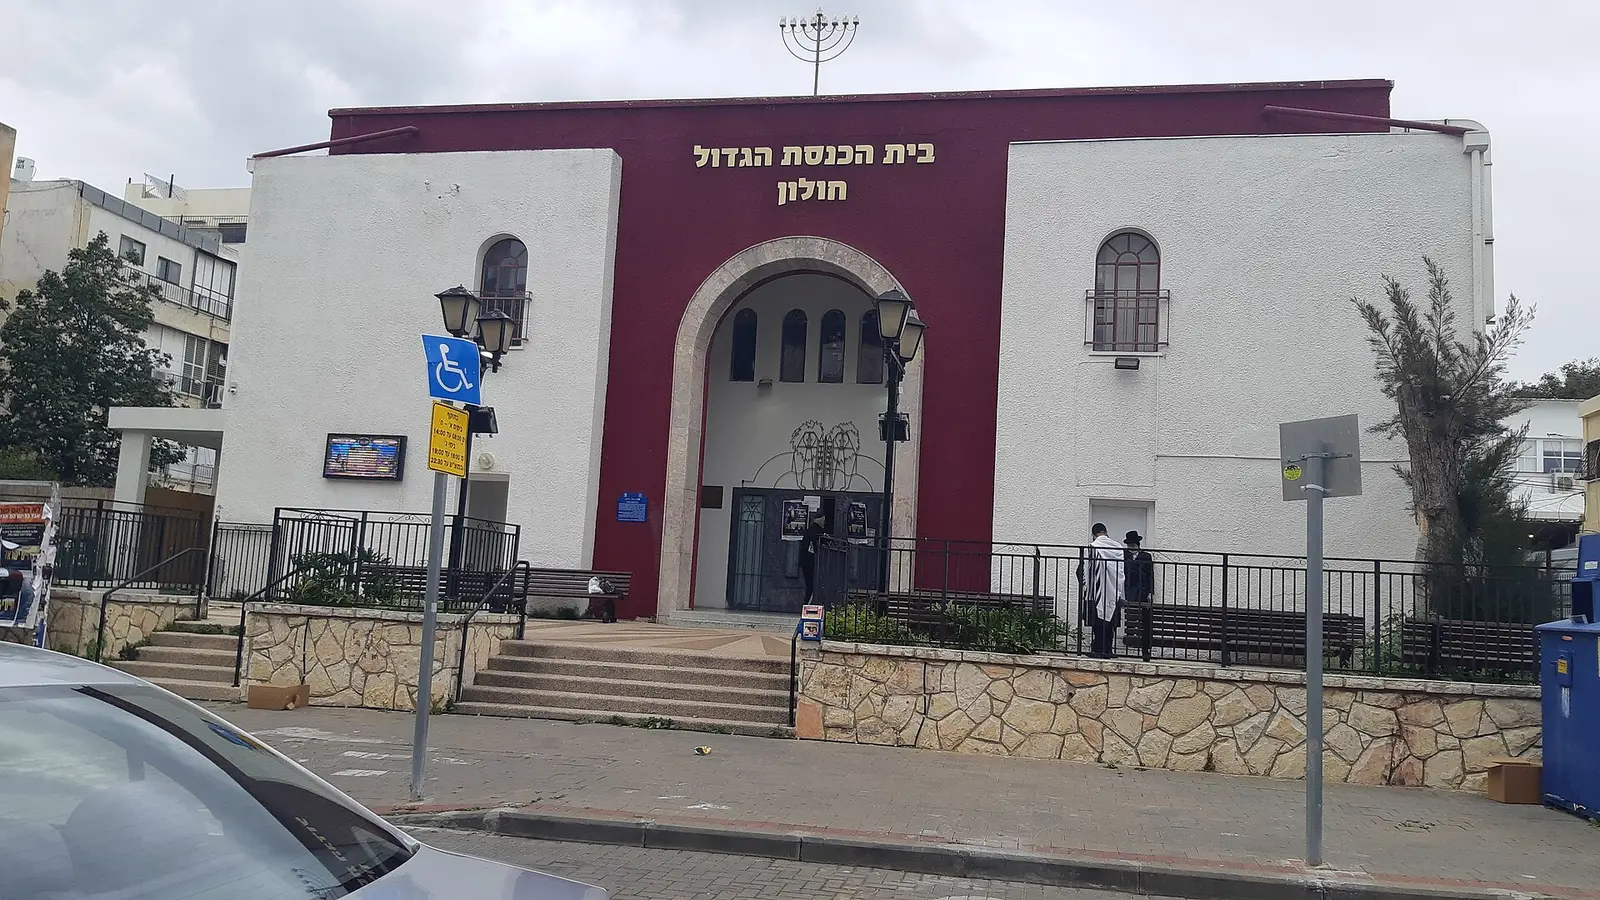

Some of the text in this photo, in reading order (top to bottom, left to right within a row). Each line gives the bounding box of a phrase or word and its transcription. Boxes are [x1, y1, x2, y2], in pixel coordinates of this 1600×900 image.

[693, 143, 936, 168] בית הכנסת הגדול
[777, 177, 848, 206] חולון
